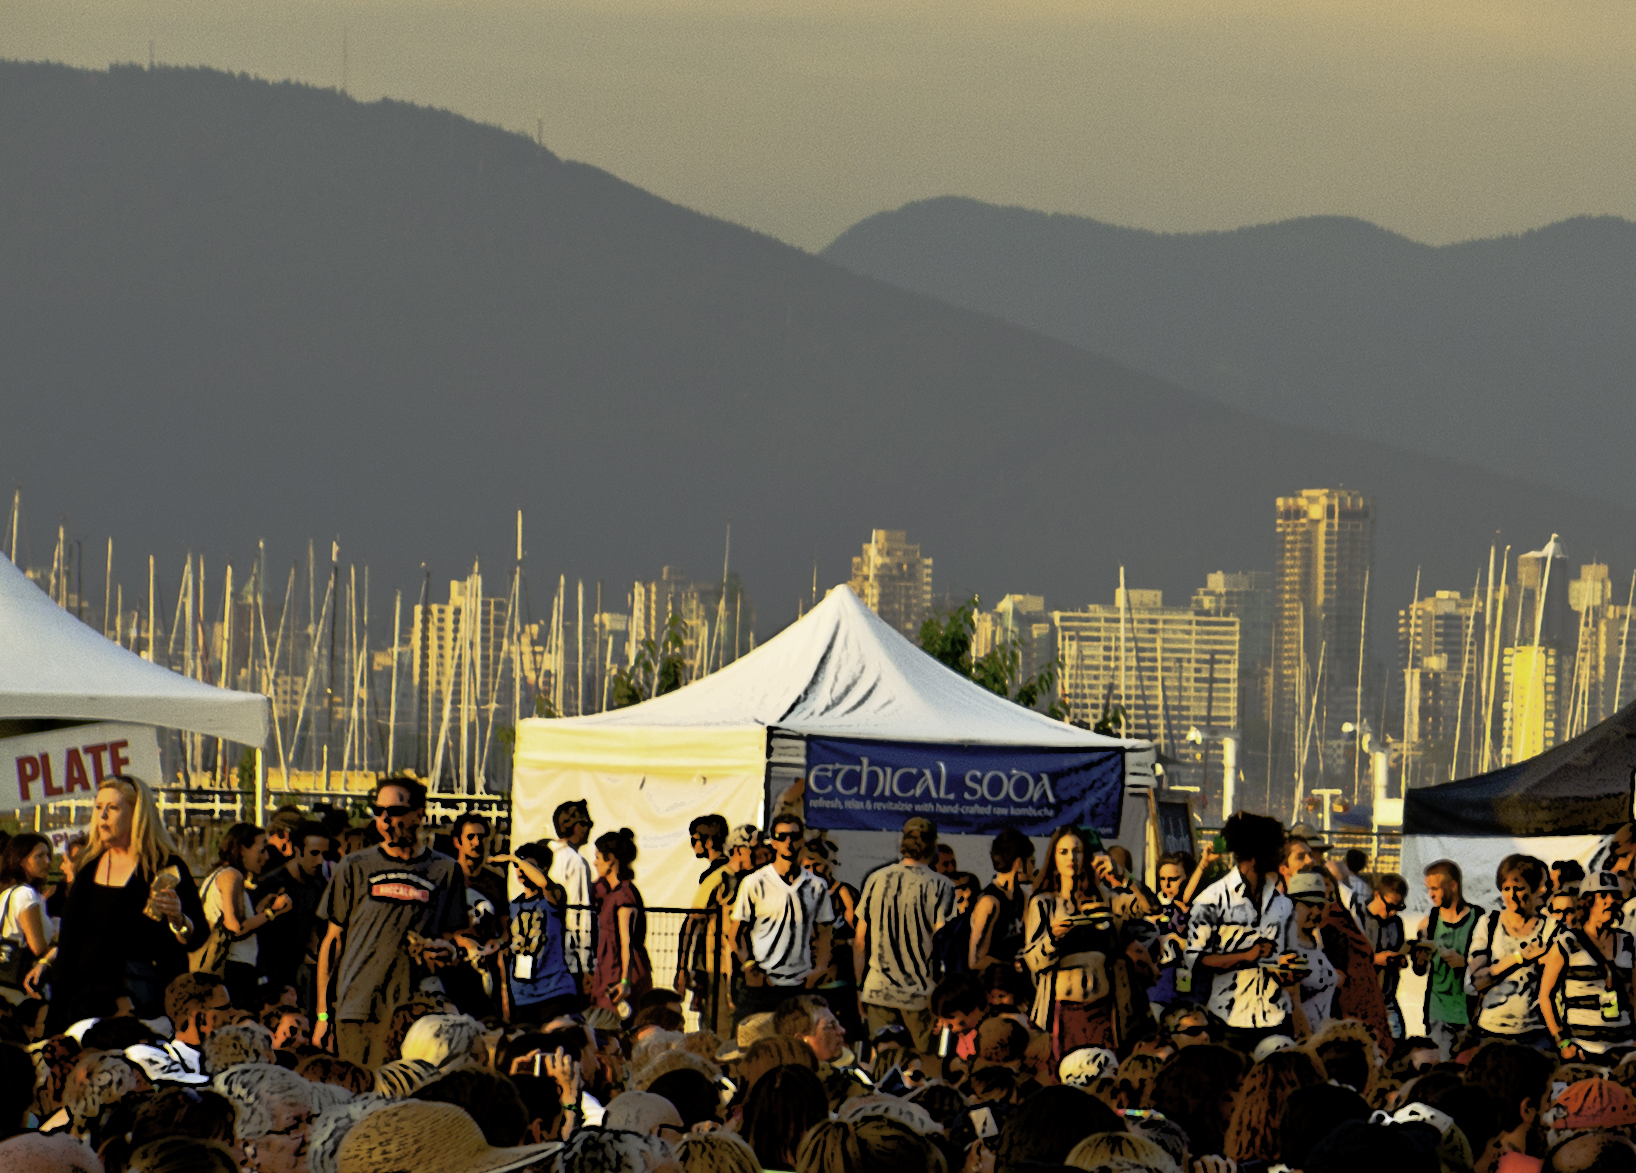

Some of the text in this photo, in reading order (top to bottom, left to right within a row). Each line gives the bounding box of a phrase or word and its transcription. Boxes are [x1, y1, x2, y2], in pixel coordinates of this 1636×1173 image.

[15, 738, 129, 801] PLATE
[914, 801, 934, 812] with
[993, 806, 1009, 815] raw
[1010, 804, 1055, 817] kombucha
